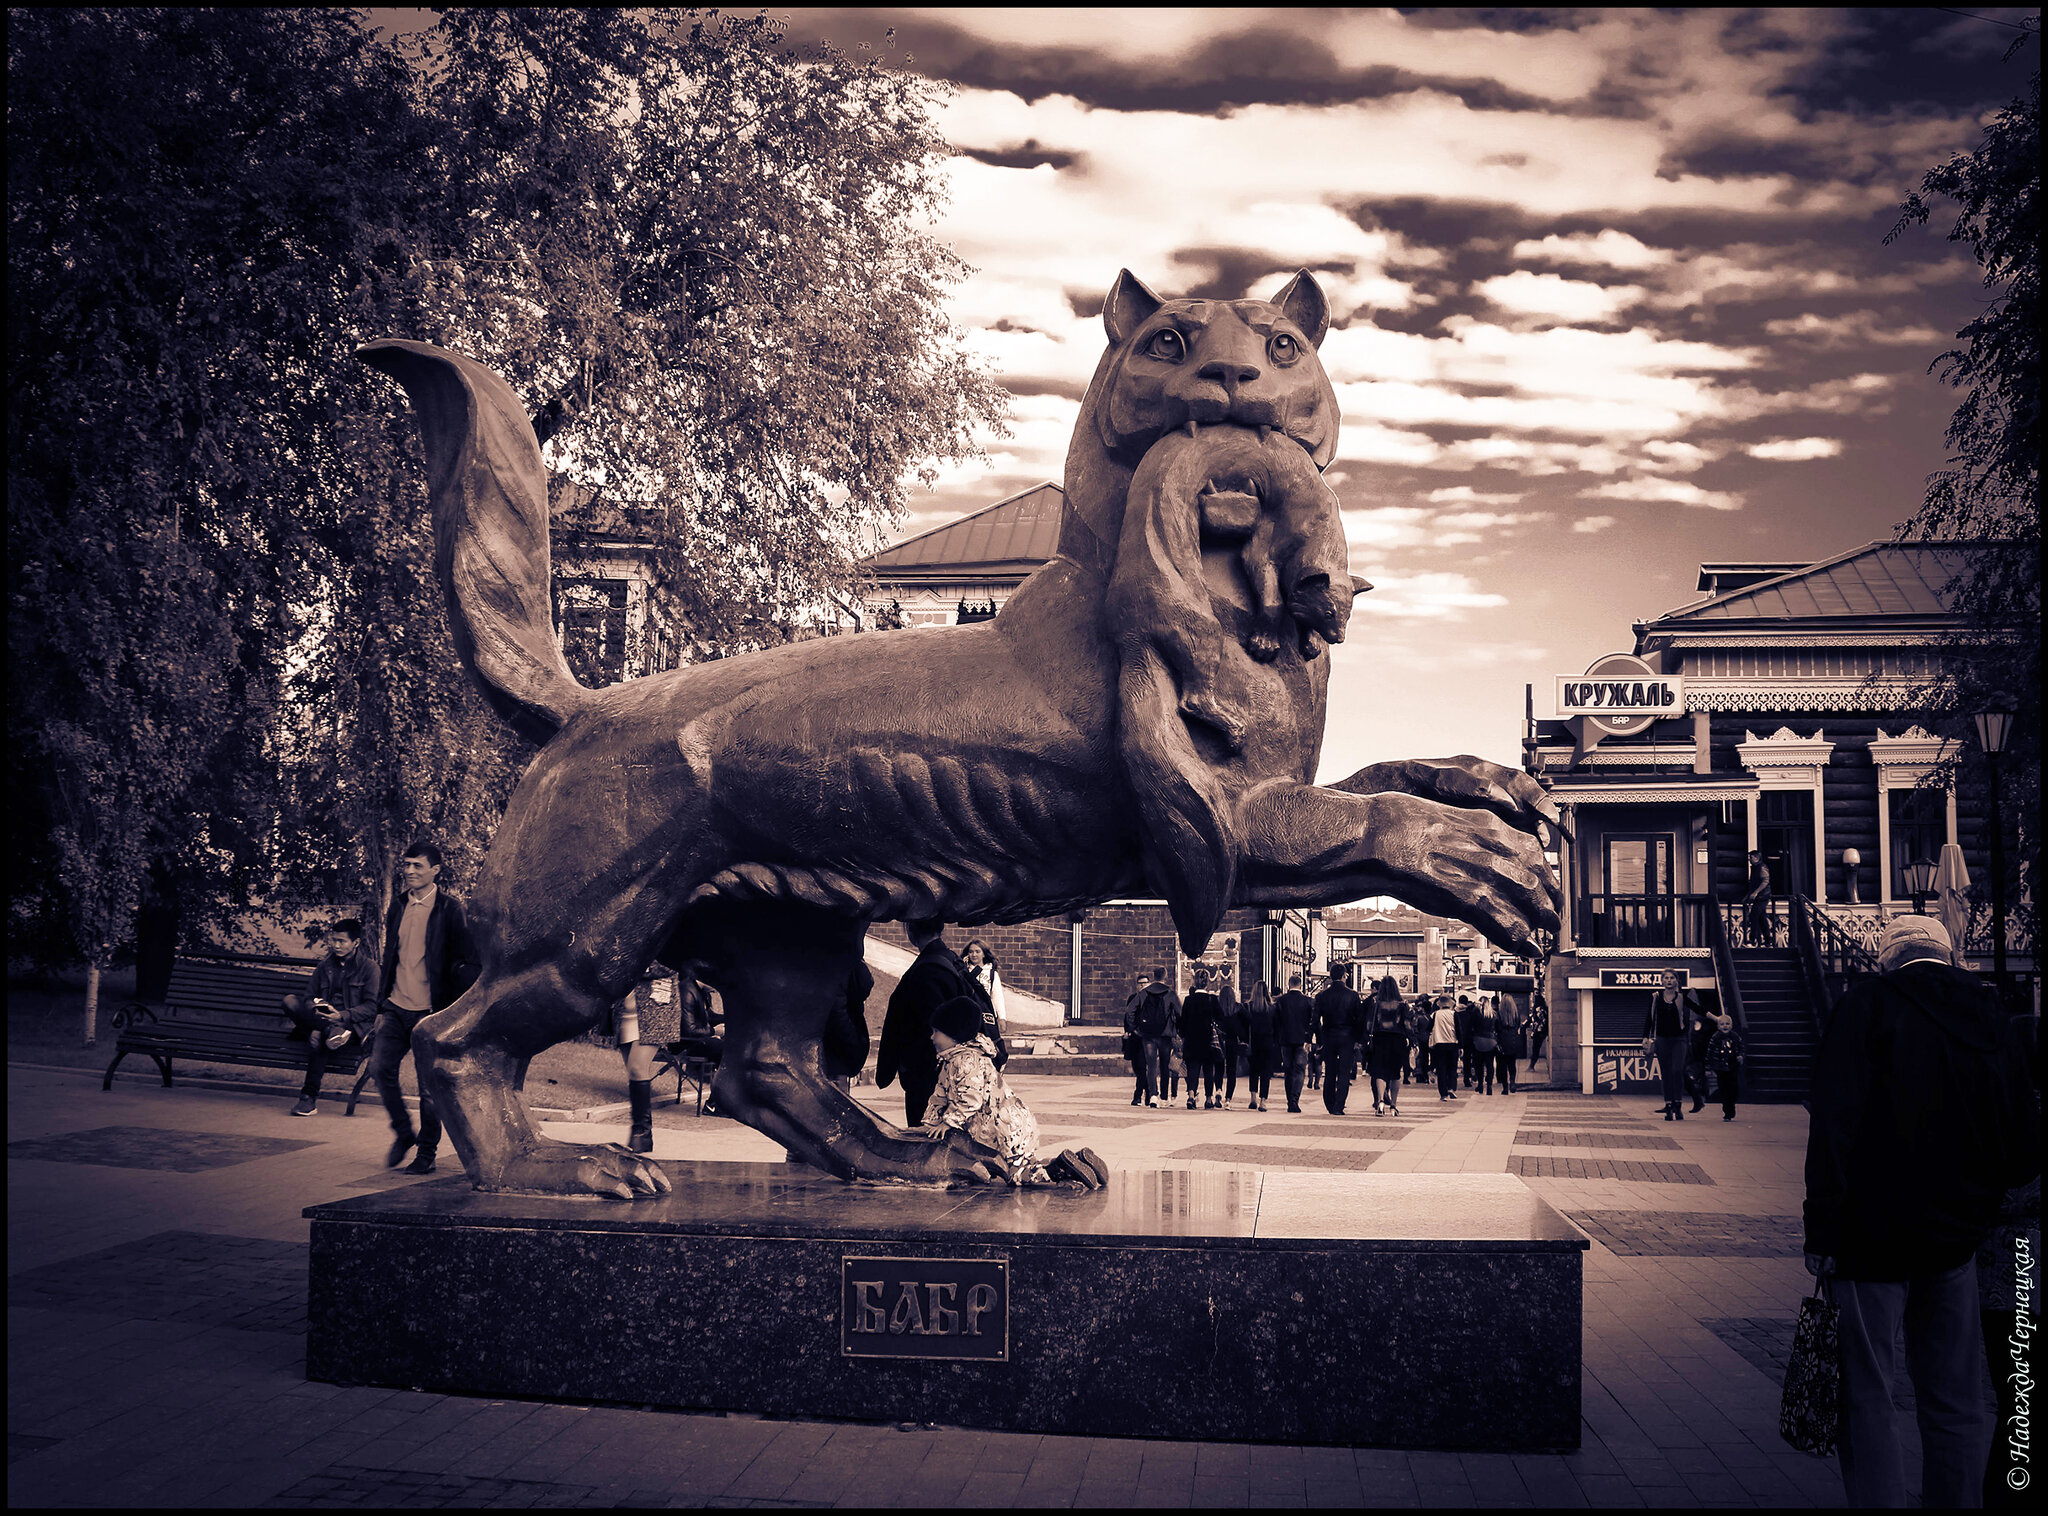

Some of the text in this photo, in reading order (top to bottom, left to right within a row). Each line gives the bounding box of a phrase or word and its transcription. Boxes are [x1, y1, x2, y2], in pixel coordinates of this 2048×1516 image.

[1564, 683, 1675, 706] КРУЖАЛЬ
[1612, 716, 1630, 724] БАР
[1616, 973, 1663, 985] ЖАЖД
[1619, 1057, 1662, 1081] КВА
[851, 1280, 998, 1336] БАБР
